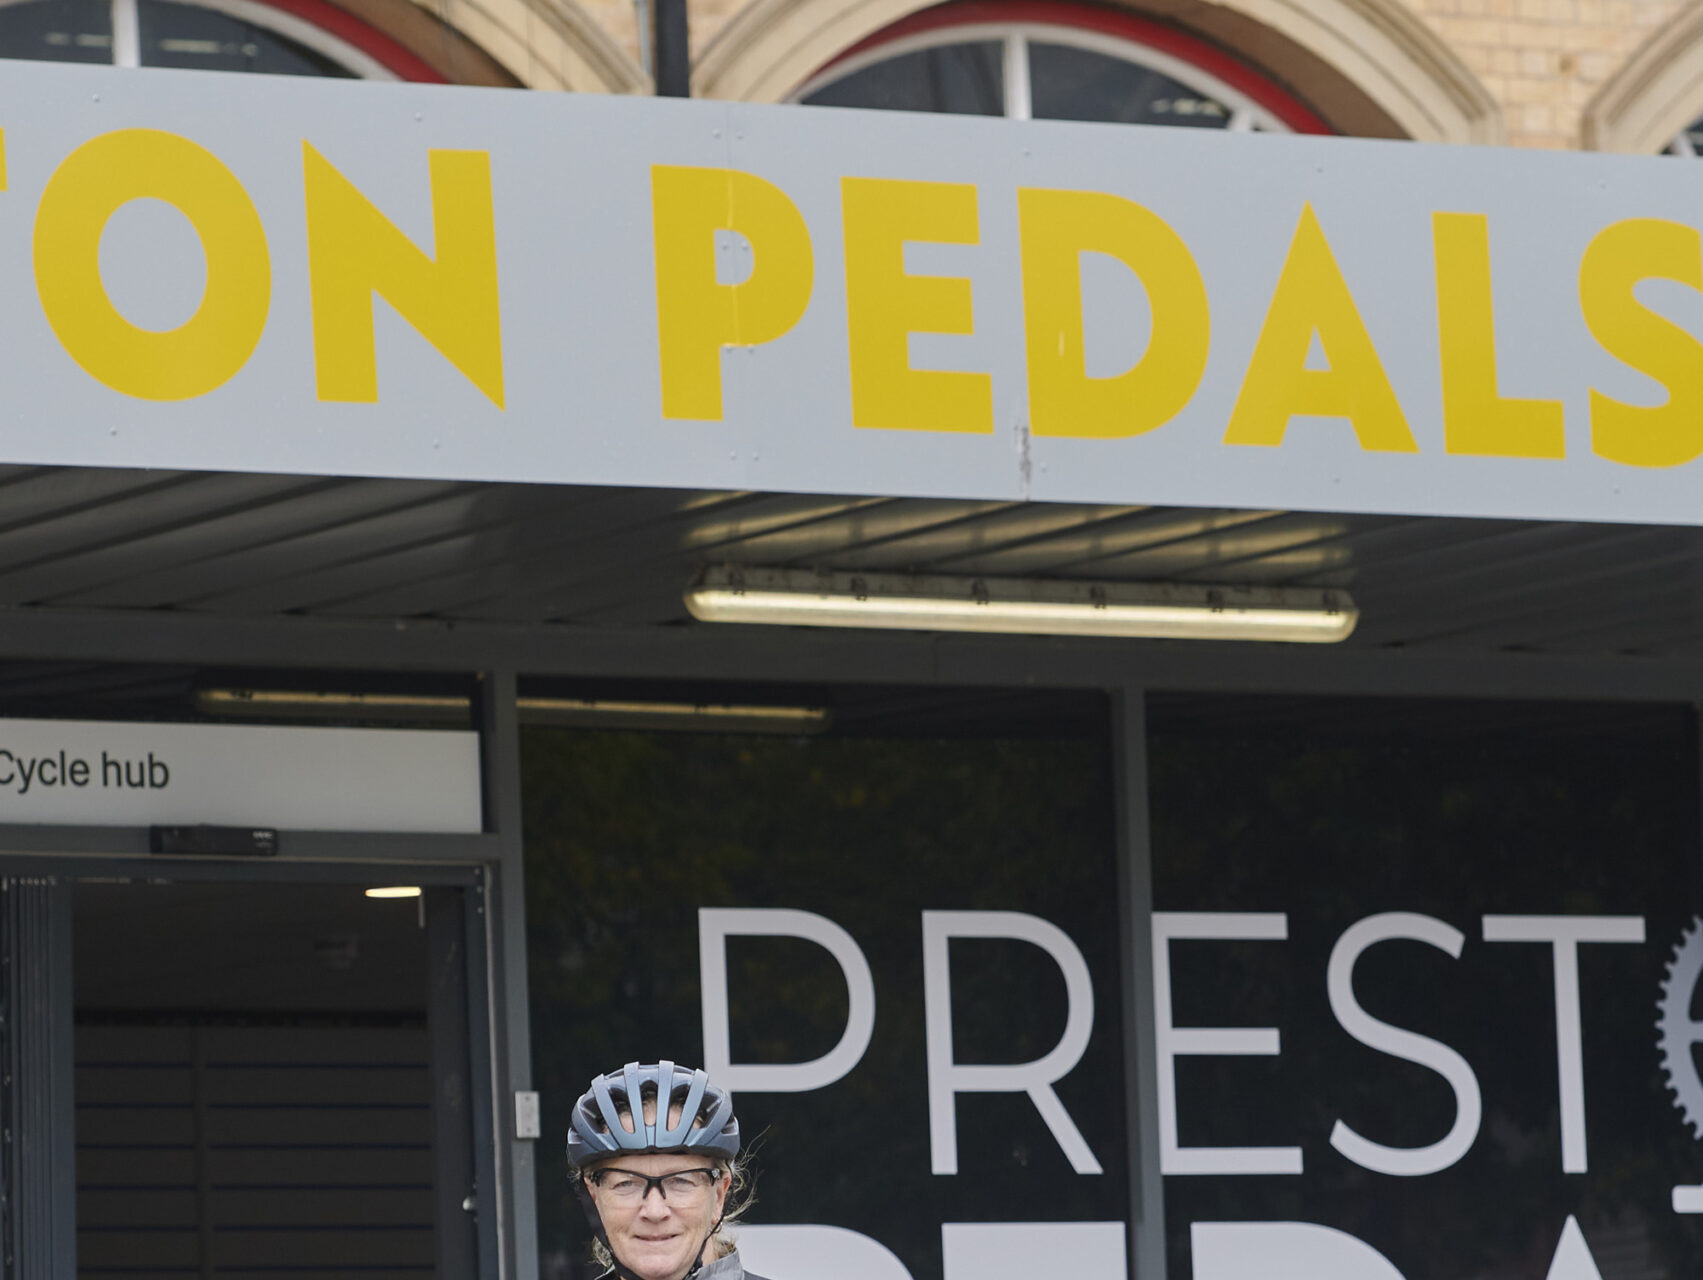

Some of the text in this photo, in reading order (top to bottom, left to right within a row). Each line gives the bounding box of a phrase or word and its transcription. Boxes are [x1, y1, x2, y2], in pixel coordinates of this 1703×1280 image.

[0, 127, 1703, 468] ON PEDALS
[0, 749, 170, 794] Cycle hub
